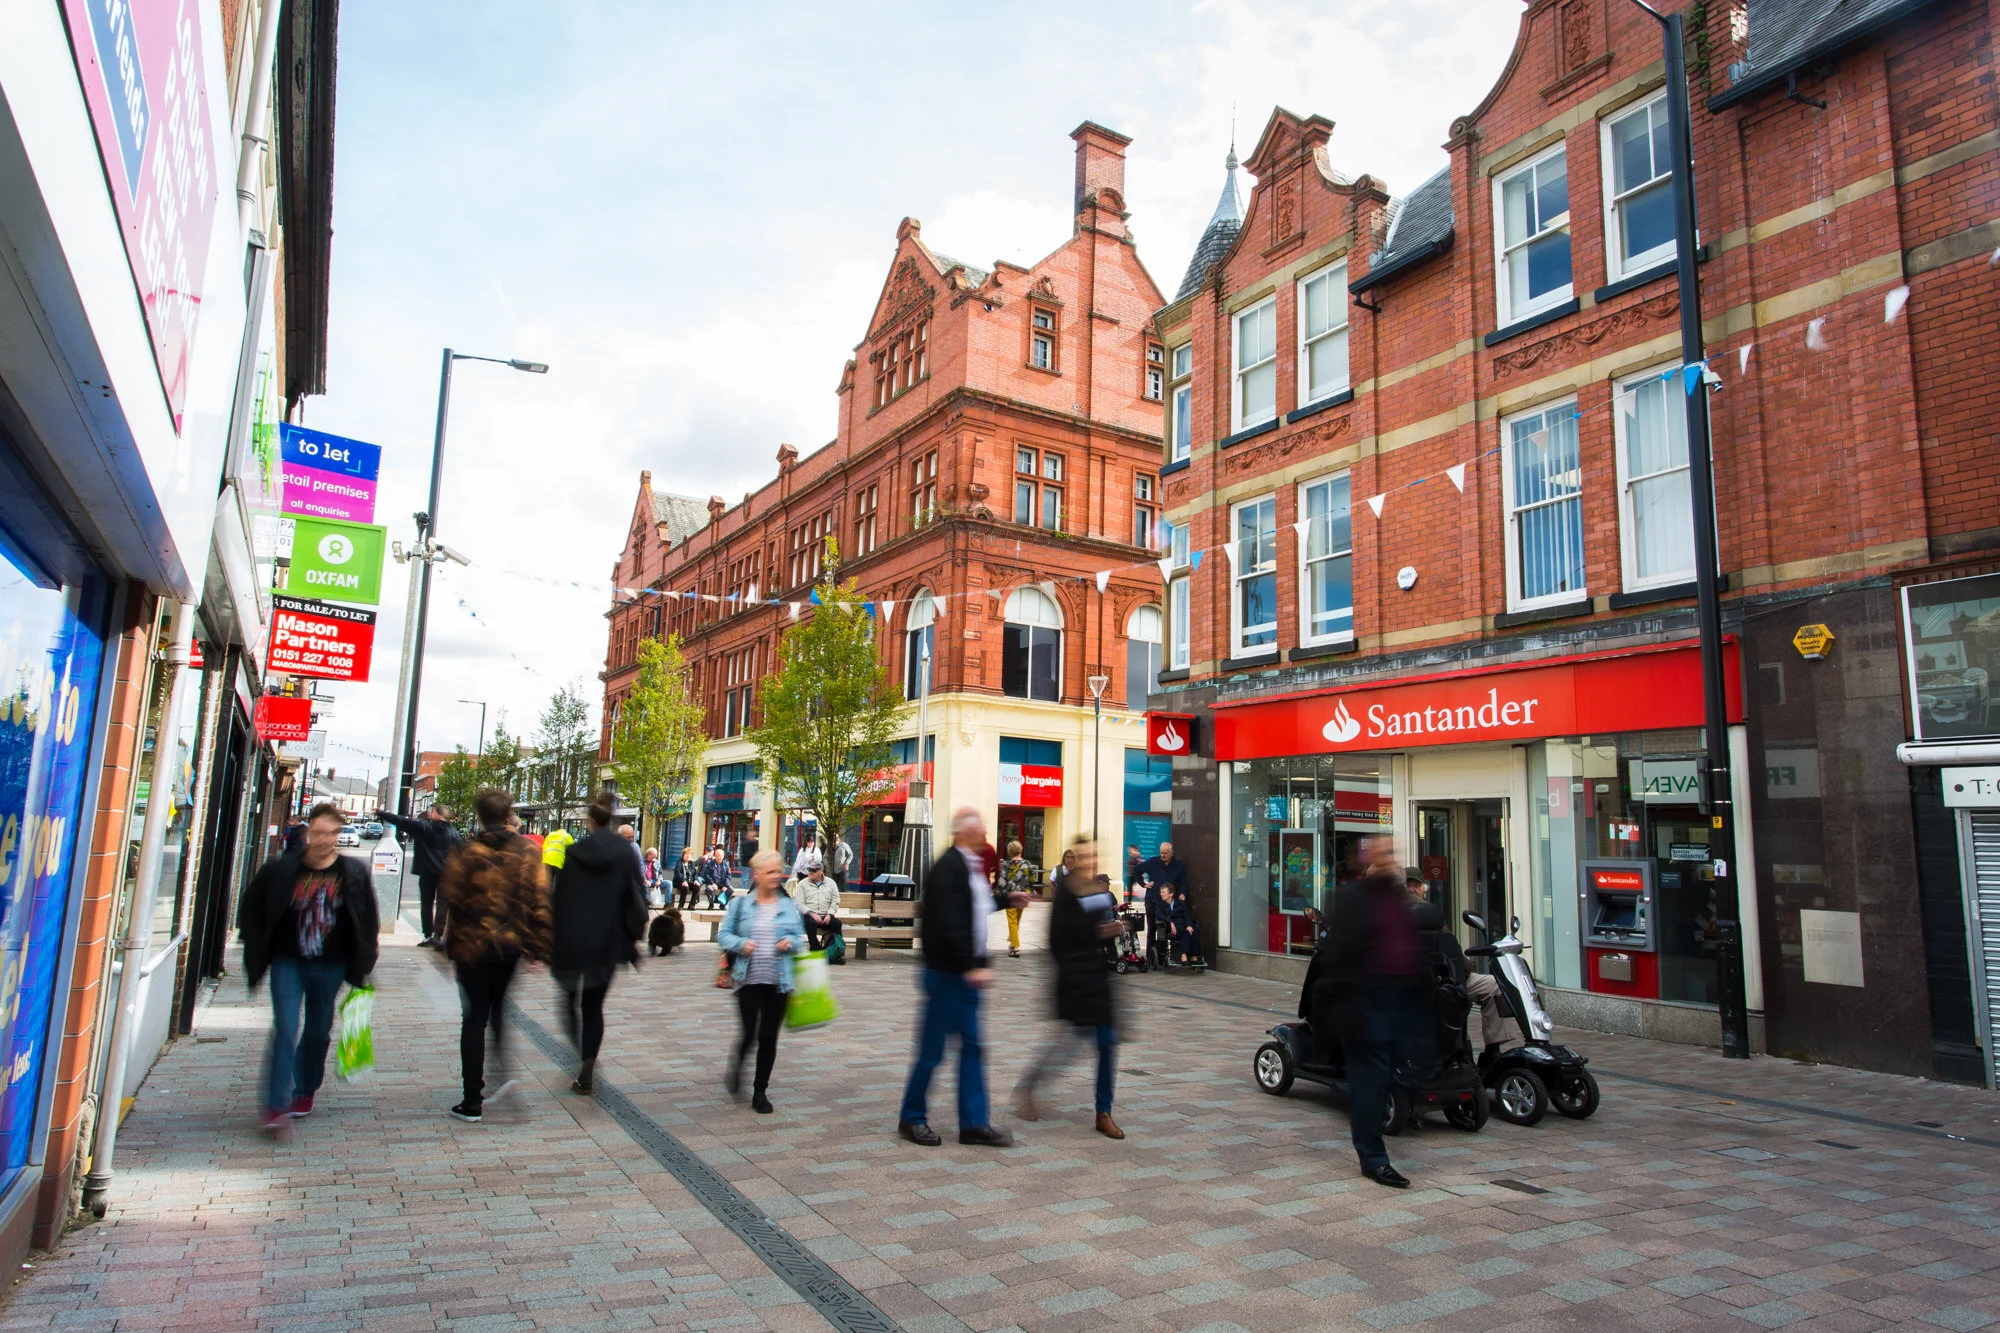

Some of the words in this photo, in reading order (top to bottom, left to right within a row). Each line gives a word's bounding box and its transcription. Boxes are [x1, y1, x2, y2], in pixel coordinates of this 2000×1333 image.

[106, 0, 145, 151] riends
[164, 48, 192, 218] PARIS
[152, 120, 178, 252] NEW
[299, 438, 319, 456] to
[322, 442, 351, 463] let
[279, 473, 311, 488] etail
[312, 479, 370, 500] premises
[290, 499, 304, 509] all
[305, 503, 350, 518] enquiries
[305, 569, 359, 589] OXFAM
[280, 599, 302, 611] FOR
[350, 612, 370, 622] LET
[277, 614, 338, 637] Mason
[275, 629, 355, 655] Partners
[271, 660, 352, 676] MASONPARTNERS.COM
[273, 648, 299, 661] 0151
[302, 652, 324, 664] 227
[327, 656, 353, 669] 1008
[1367, 687, 1539, 738] Santander
[262, 729, 307, 738] clearance
[264, 723, 301, 731] branded
[1002, 774, 1023, 784] home
[1025, 775, 1061, 788] bargains
[14, 814, 66, 903] you
[1607, 876, 1639, 885] Santander
